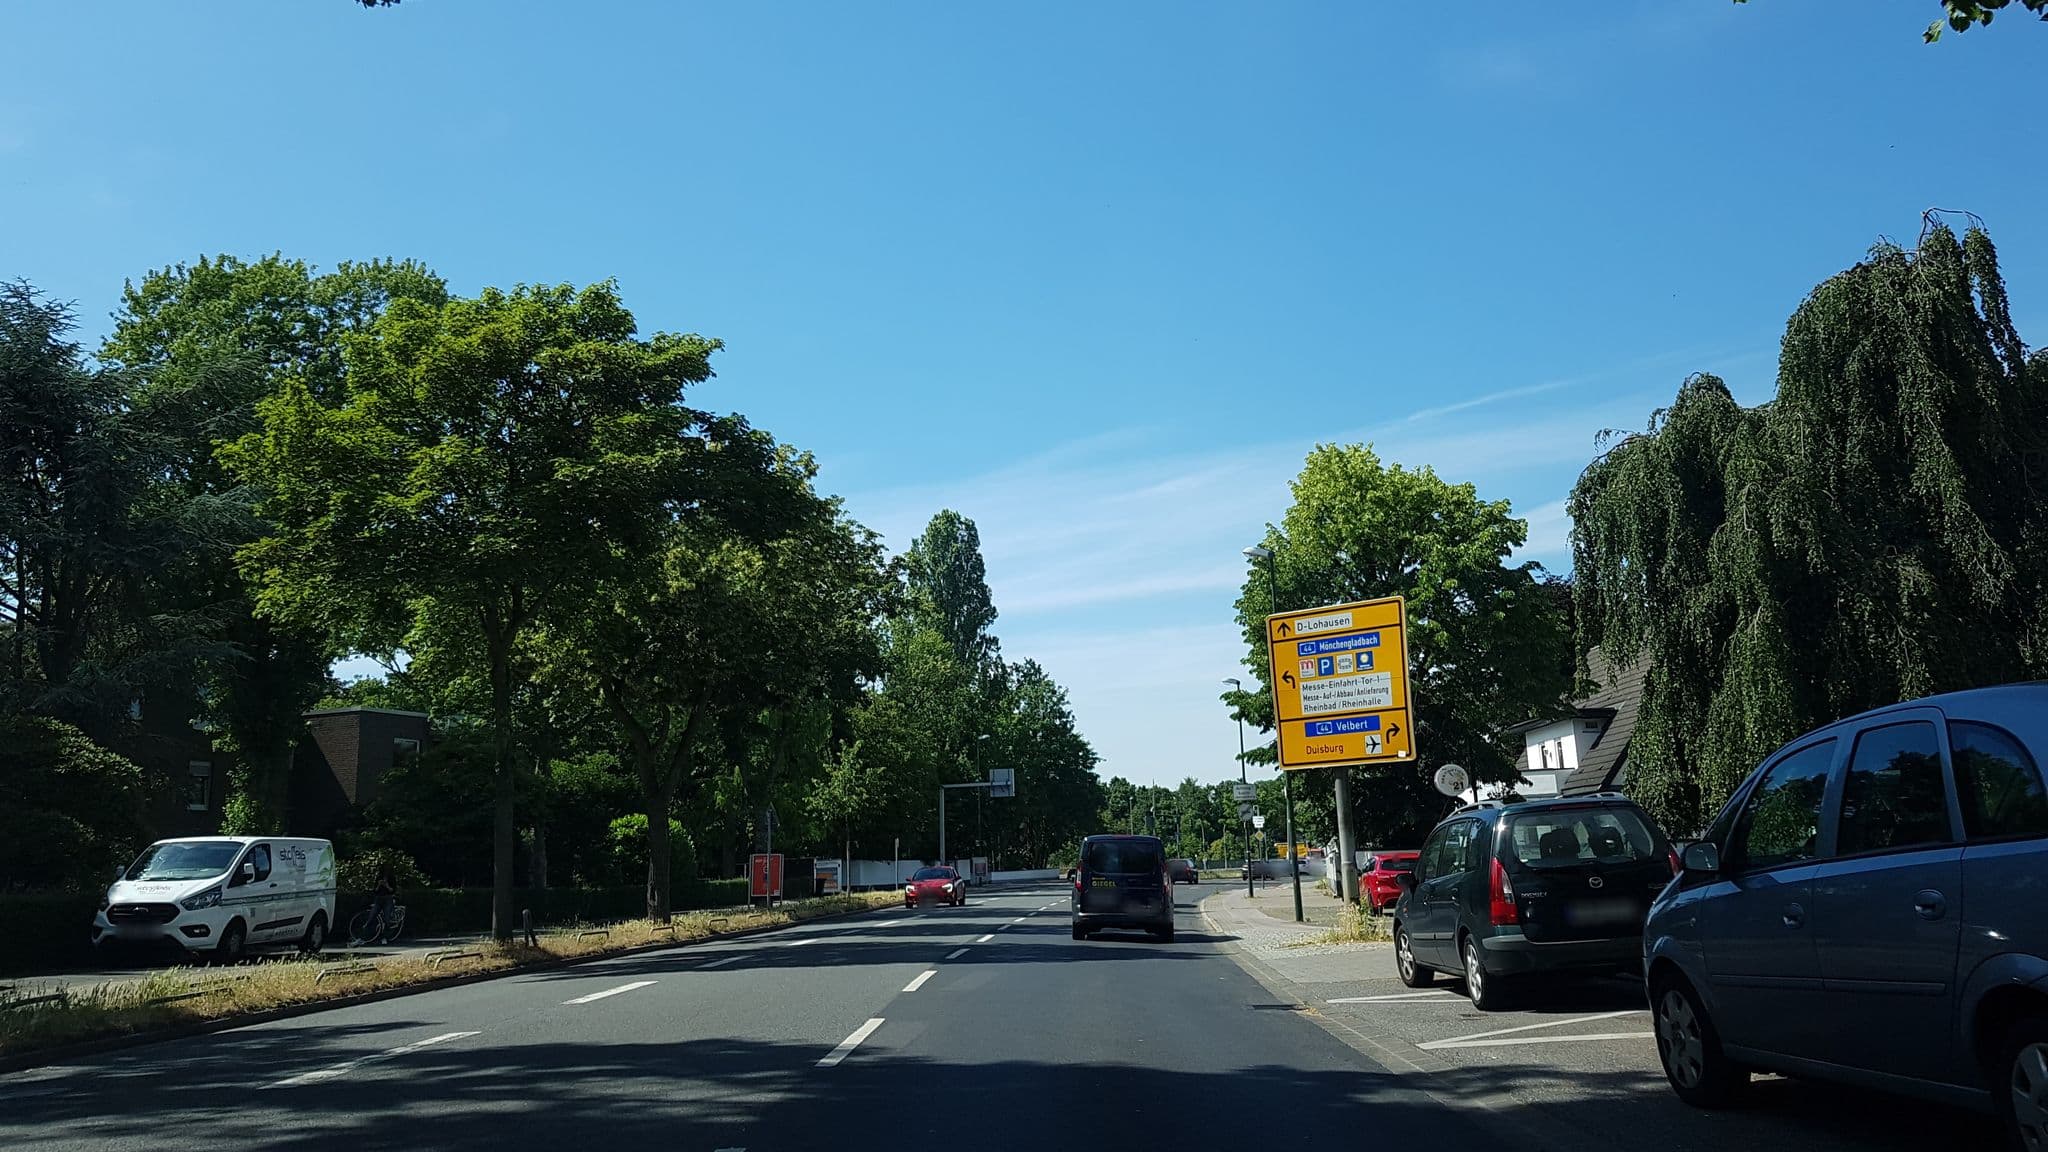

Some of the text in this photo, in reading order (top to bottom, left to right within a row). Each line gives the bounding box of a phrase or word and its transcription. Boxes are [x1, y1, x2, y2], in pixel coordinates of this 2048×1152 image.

[1298, 617, 1350, 631] D-Lohausen
[1319, 635, 1378, 651] Mönchengladbach
[1336, 720, 1368, 731] Velbert
[1306, 745, 1344, 755] Duisburg
[1453, 781, 1464, 790] 21
